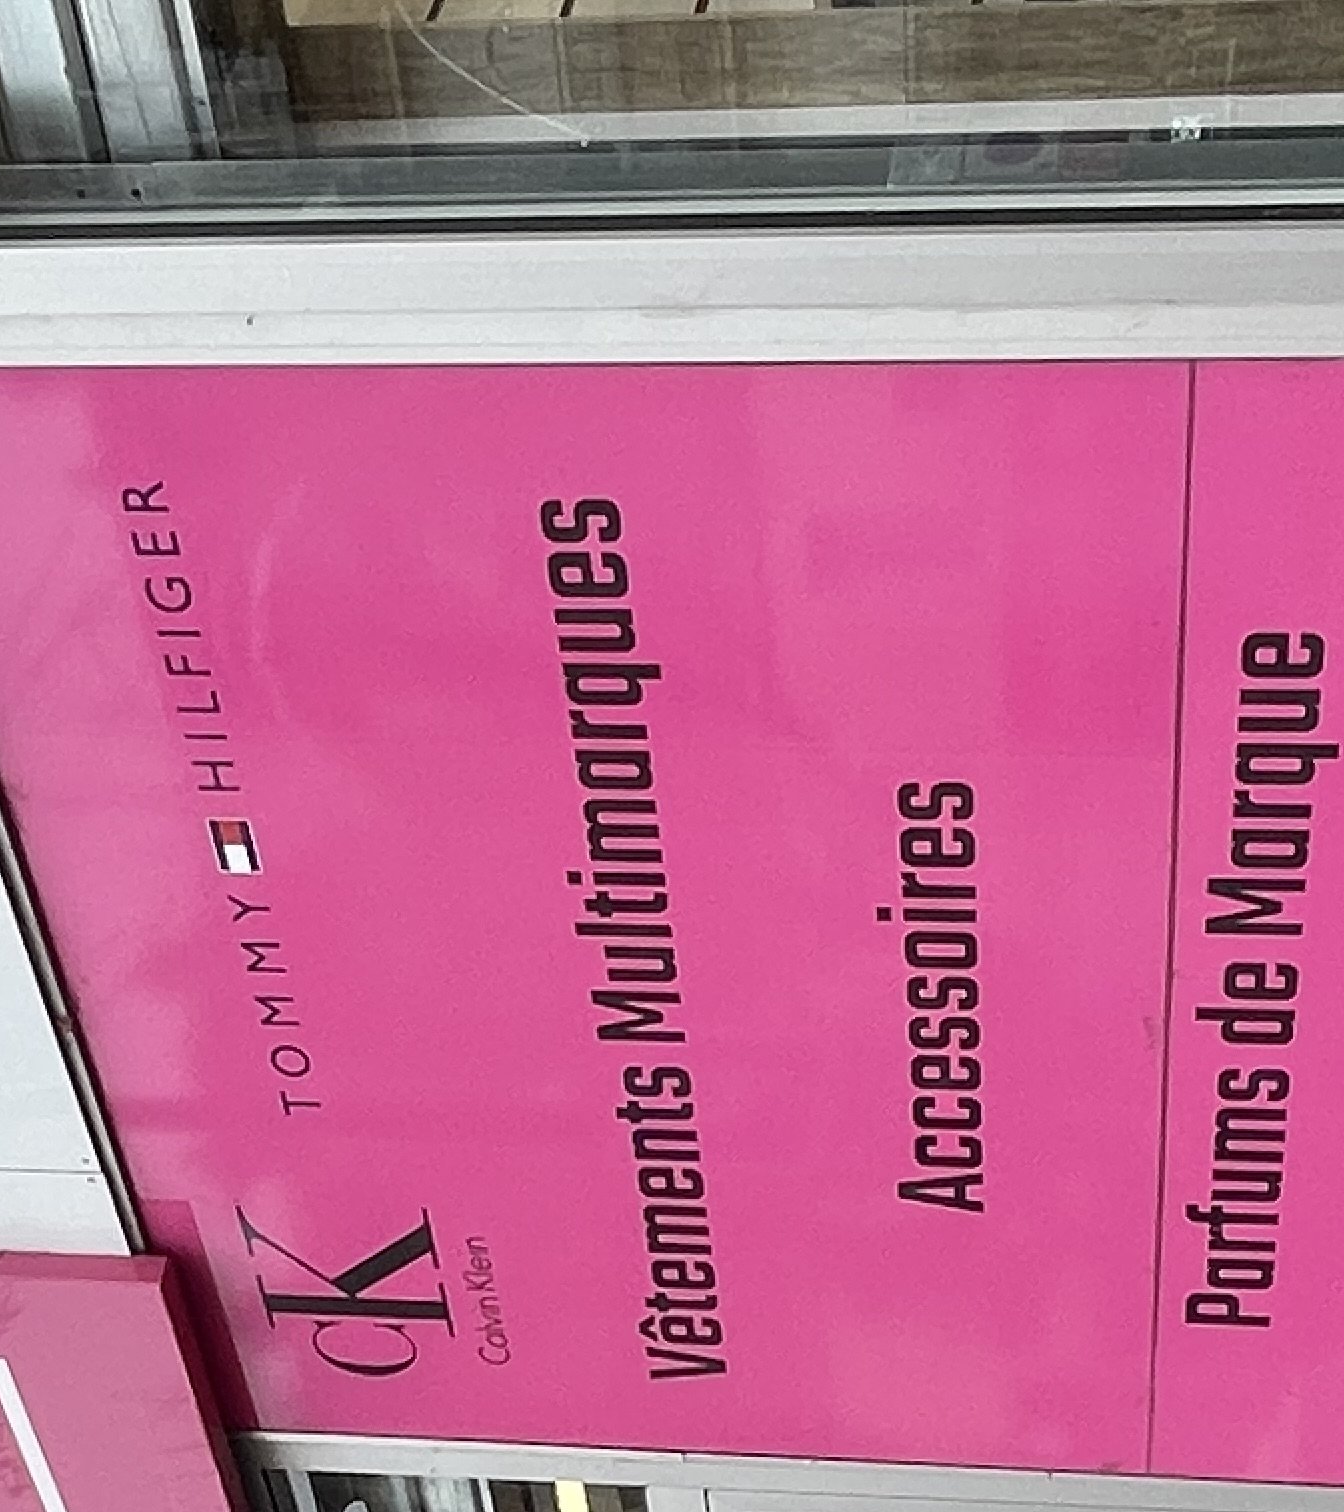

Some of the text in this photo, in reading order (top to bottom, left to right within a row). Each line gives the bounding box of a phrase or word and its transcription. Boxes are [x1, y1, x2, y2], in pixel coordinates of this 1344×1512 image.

[121, 480, 322, 1116] TOMMY HILFIGER
[539, 498, 728, 1380] Vêtements Multimarques
[876, 780, 985, 1214] Accessoires
[1184, 631, 1340, 1328] Parfums de Marque
[461, 1236, 511, 1366] Calvin Klein
